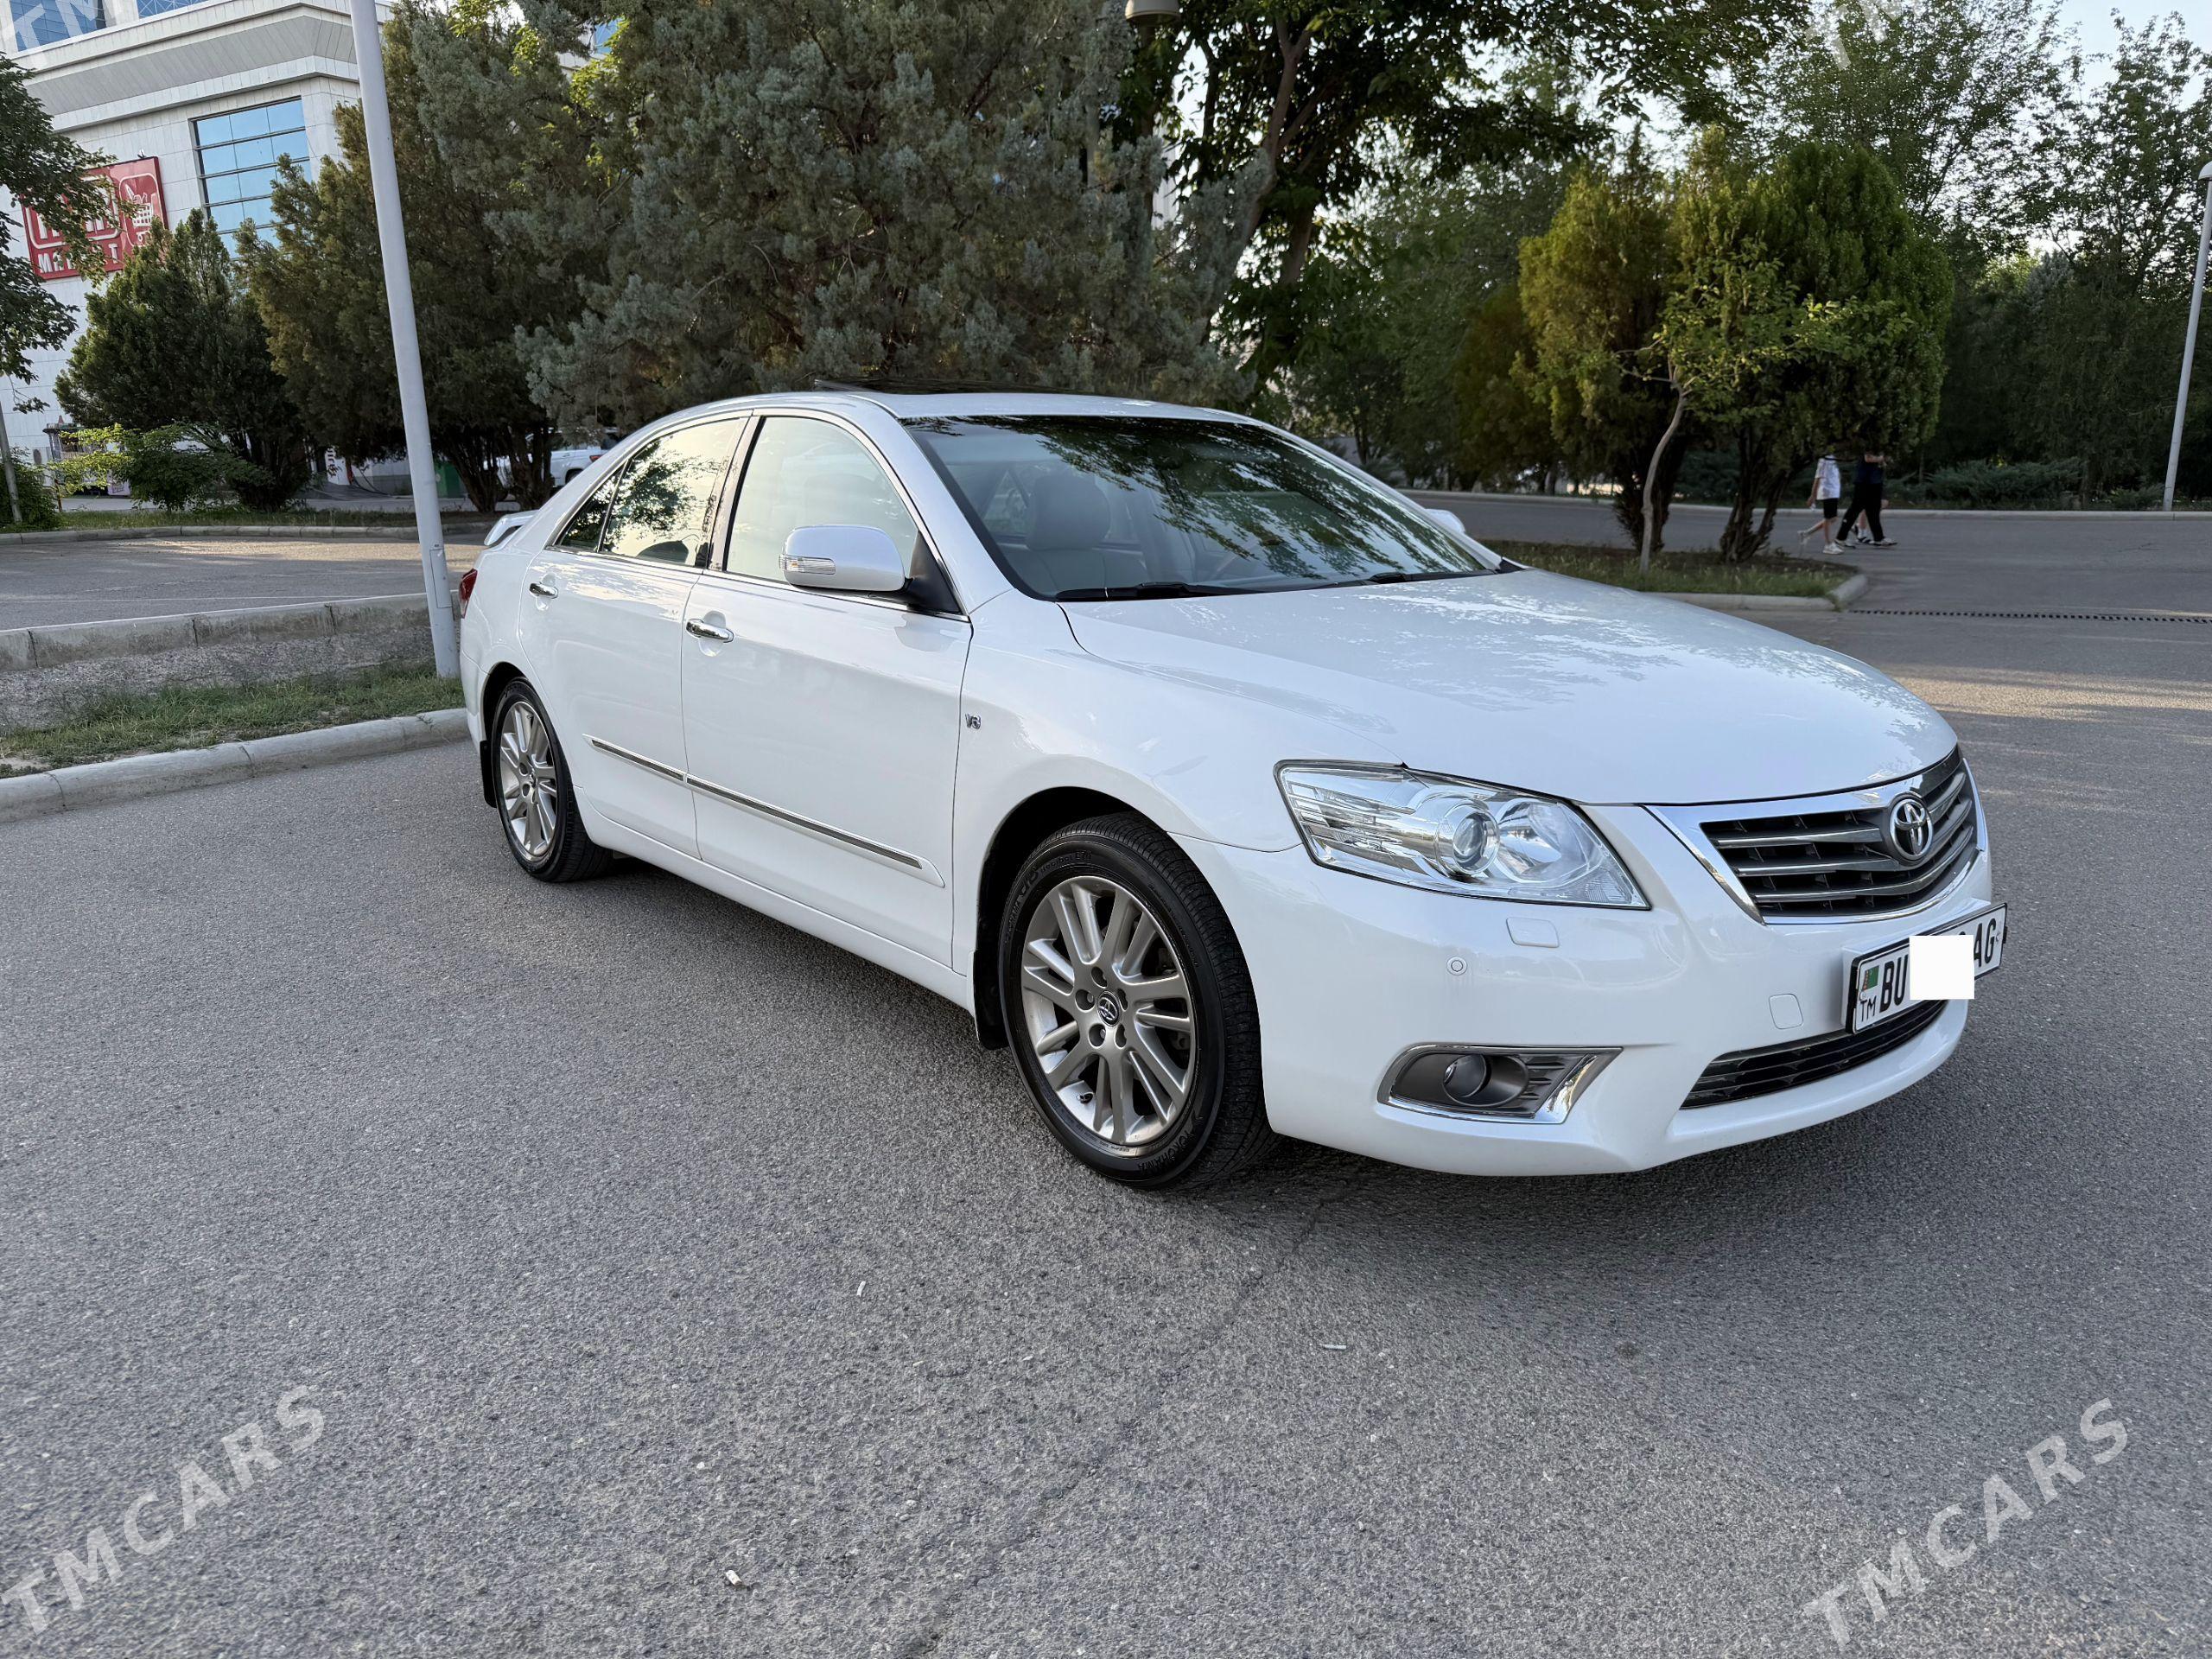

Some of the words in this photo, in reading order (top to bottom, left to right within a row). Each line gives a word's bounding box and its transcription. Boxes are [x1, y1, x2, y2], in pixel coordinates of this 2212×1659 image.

[1879, 954, 1909, 1013] BU
[1974, 918, 1997, 968] AG
[1860, 995, 1878, 1022] TM
